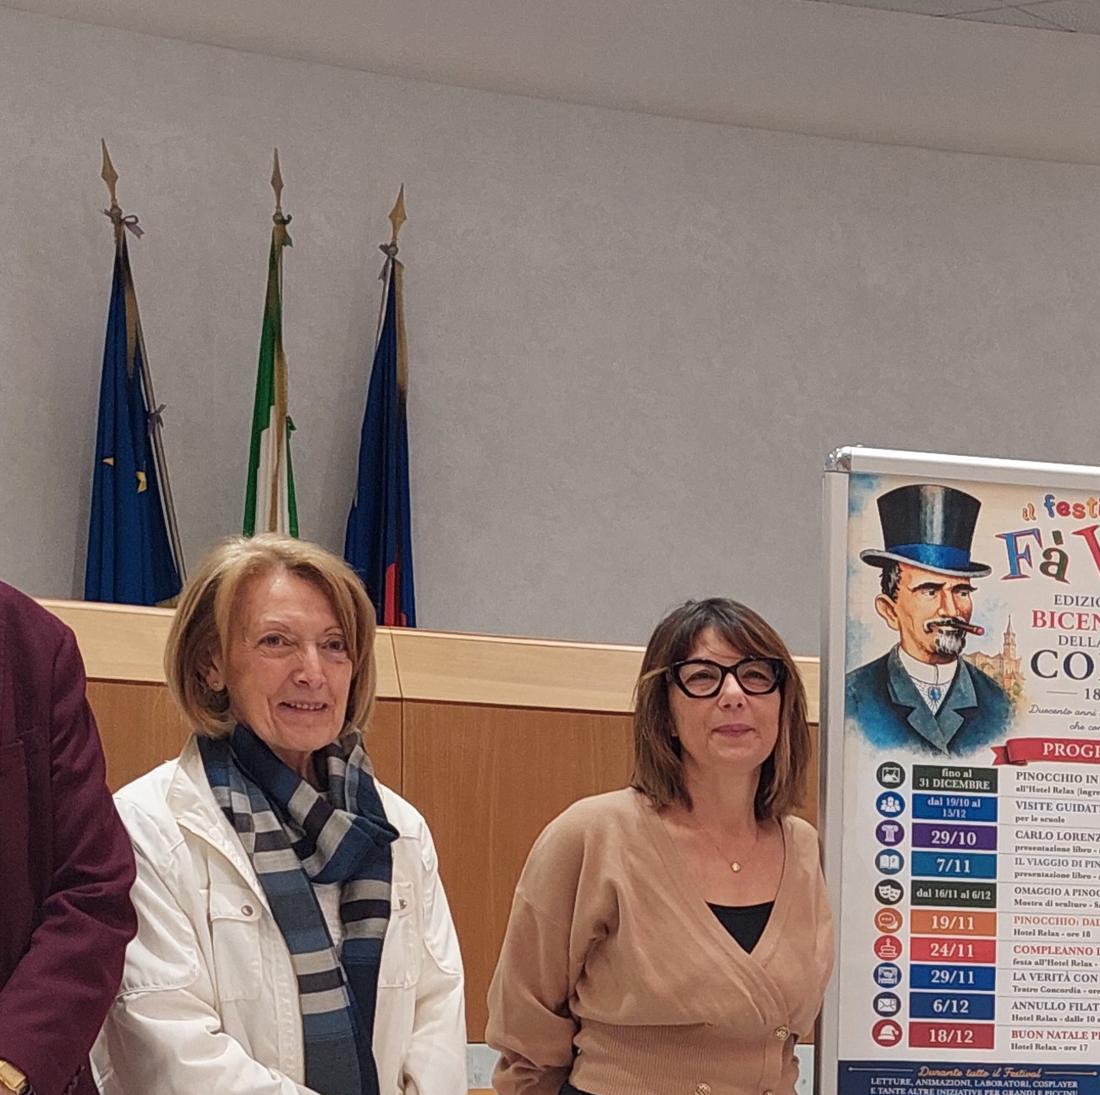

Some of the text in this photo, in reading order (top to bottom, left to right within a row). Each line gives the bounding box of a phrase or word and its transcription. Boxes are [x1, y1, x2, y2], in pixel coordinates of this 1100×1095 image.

[1022, 503, 1036, 521] il
[1028, 704, 1072, 716] Duecento
[1075, 708, 1097, 716] anni
[1069, 721, 1085, 731] che
[941, 768, 972, 778] fino al
[1016, 771, 1083, 784] PINOCCHIO
[1086, 775, 1099, 784] IN
[919, 778, 991, 790] 31 DICEMBRE
[927, 796, 981, 808] dal 19/10 al
[1016, 800, 1053, 812] VISITE
[942, 808, 967, 819] 15/12
[931, 830, 977, 846] 29/10
[1015, 830, 1053, 841] CARLO
[936, 857, 971, 873] 7/11
[1015, 857, 1025, 866] IL
[1028, 858, 1069, 868] VIAGGIO
[1072, 860, 1082, 868] DI
[916, 888, 991, 900] dal 16/11 al 6/12
[1014, 886, 1062, 896] OMAGGIO
[1064, 888, 1071, 896] A
[931, 915, 974, 930] 19/11
[930, 943, 974, 958] 24/11
[1013, 944, 1094, 956] COMPLEANNO
[930, 970, 975, 984] 29/11
[1013, 972, 1026, 981] LA
[1029, 970, 1071, 982] VERITÀ
[1073, 973, 1099, 983] CON
[933, 999, 969, 1013] 6/12
[1012, 1001, 1066, 1011] ANNULLO
[929, 1029, 974, 1043] 18/12
[1011, 1030, 1044, 1040] BUON
[1047, 1031, 1088, 1041] NATALE
[918, 1066, 1042, 1079] Durante tutto Festival
[1033, 1080, 1078, 1089] COSPLAYER
[878, 1087, 906, 1095] TANTE
[908, 1088, 935, 1095] ALTRE
